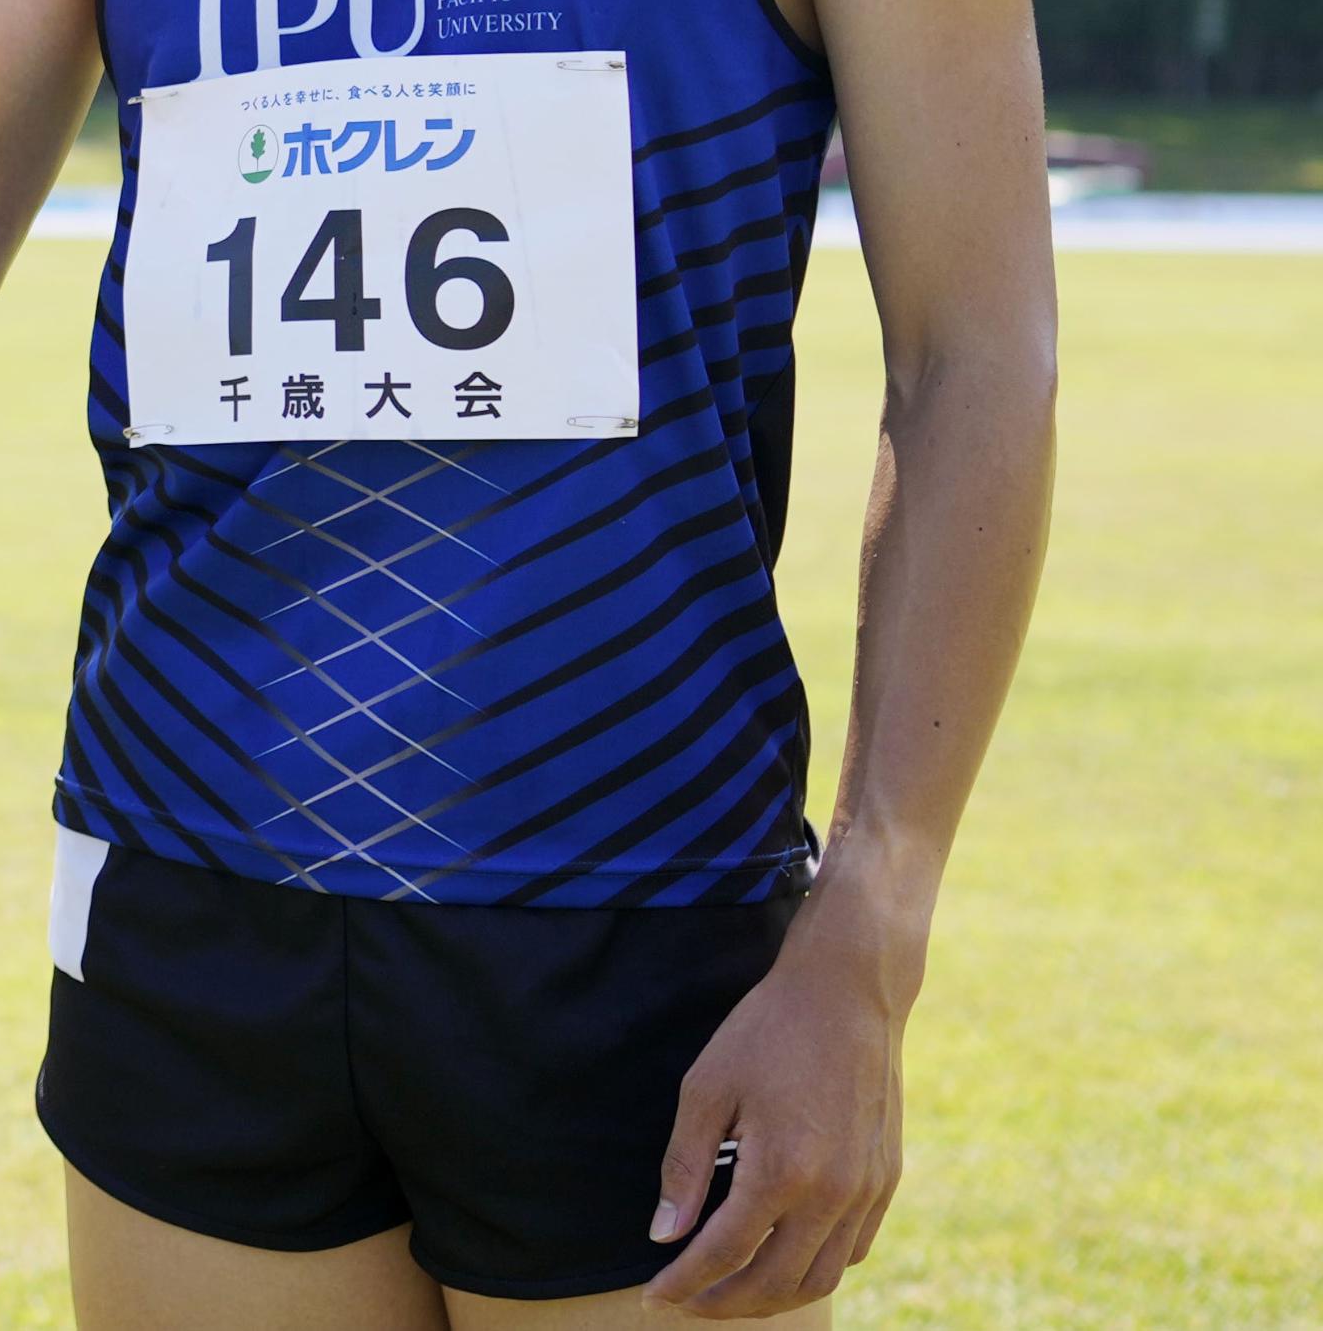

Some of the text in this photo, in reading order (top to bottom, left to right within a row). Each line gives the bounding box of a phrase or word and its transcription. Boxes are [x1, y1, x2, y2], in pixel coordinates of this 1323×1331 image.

[437, 11, 564, 41] UNIVERSITY
[281, 118, 477, 178] ホクレン
[205, 206, 516, 357] 146
